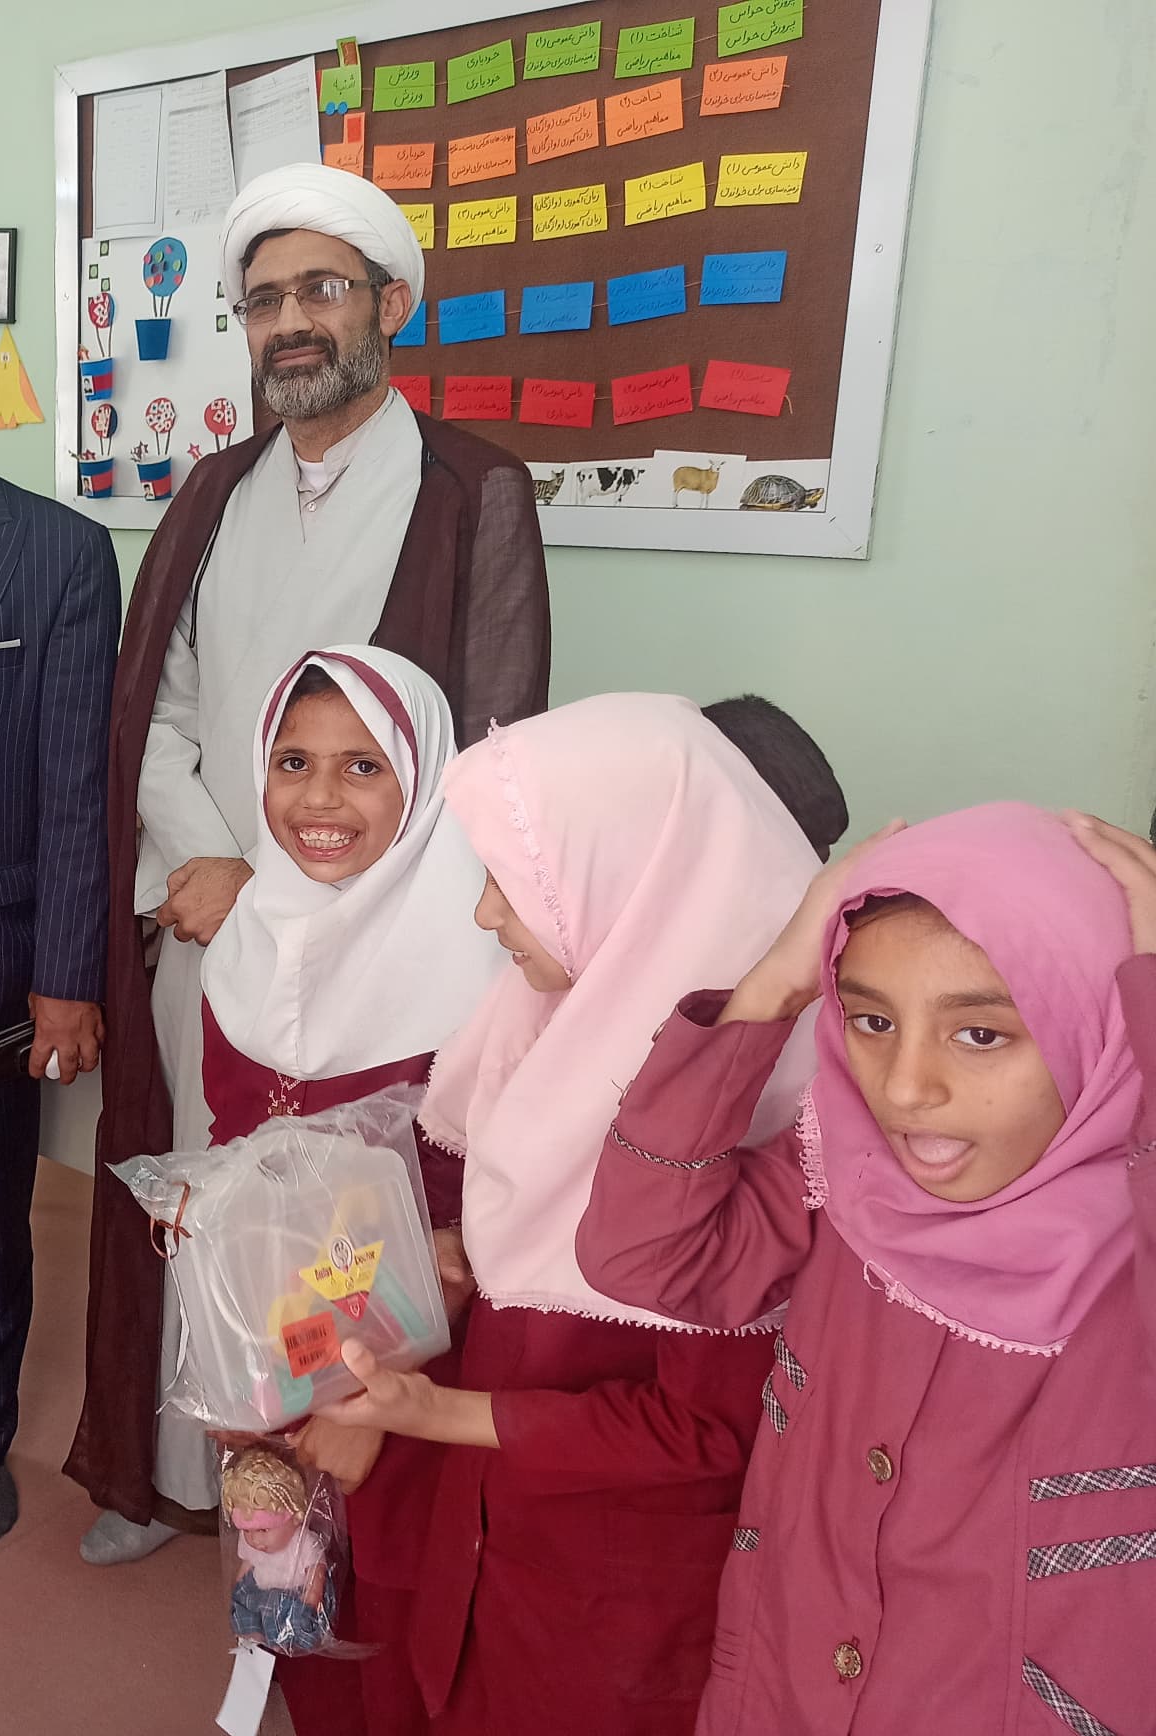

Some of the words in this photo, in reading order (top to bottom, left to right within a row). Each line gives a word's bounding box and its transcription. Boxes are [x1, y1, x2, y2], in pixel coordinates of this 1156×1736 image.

[571, 26, 596, 46] دانش
[645, 23, 683, 41] شناخت
[761, 20, 796, 41] پرورش
[546, 34, 573, 48] عمومی
[625, 53, 650, 71] ریاضی
[649, 47, 681, 72] مفاهیم
[388, 66, 420, 86] ورزش
[393, 91, 423, 108] ورزش
[771, 157, 800, 176] دانش
